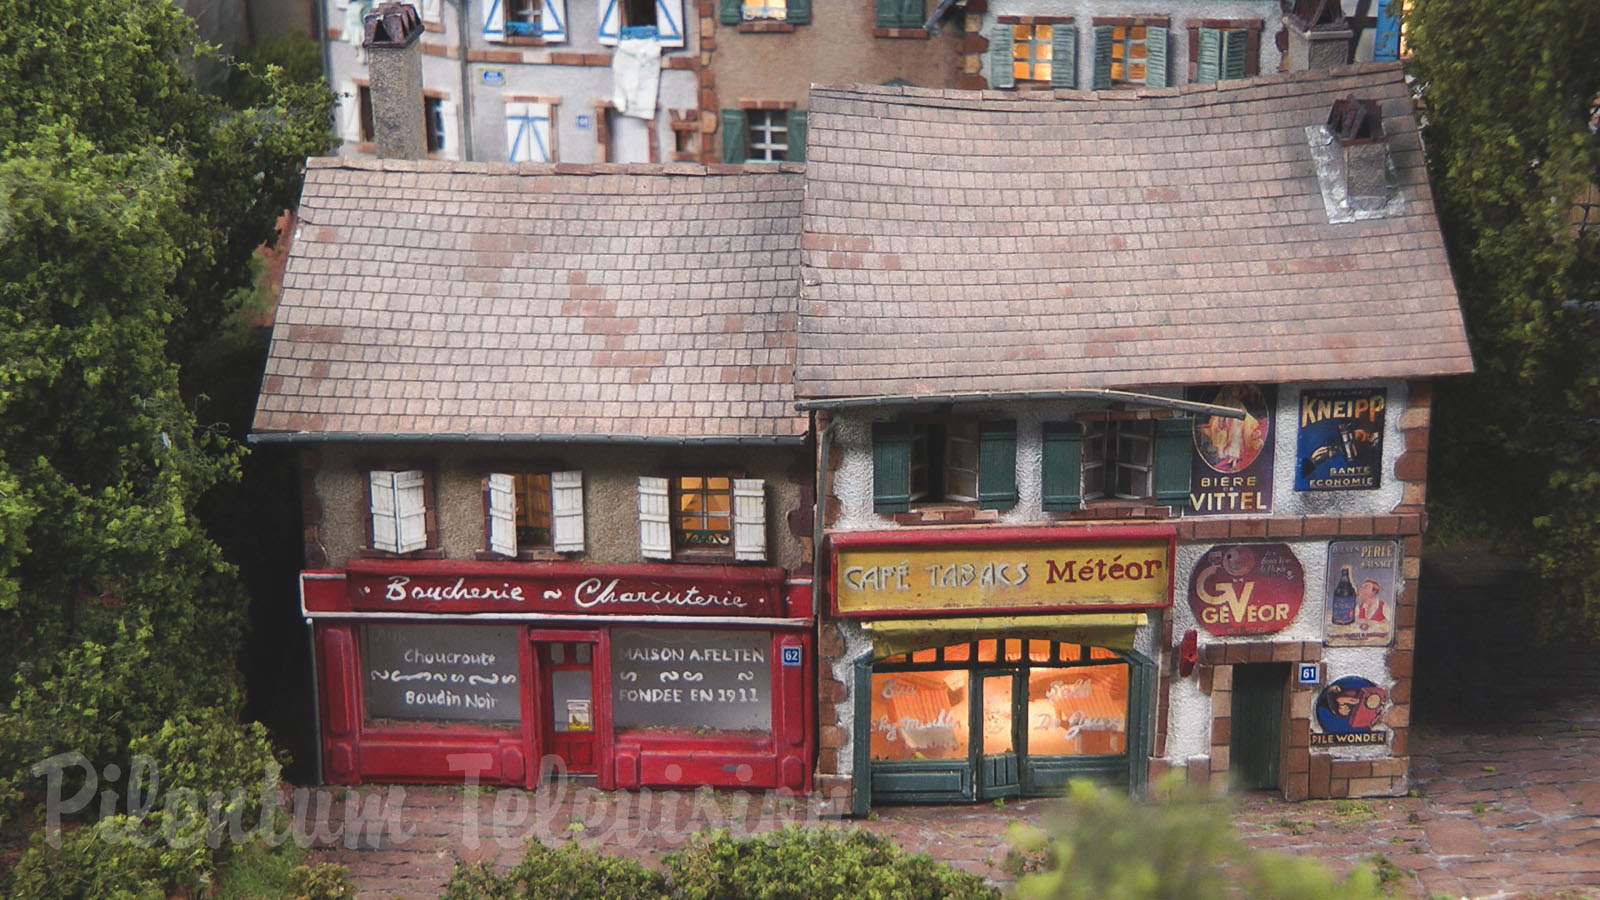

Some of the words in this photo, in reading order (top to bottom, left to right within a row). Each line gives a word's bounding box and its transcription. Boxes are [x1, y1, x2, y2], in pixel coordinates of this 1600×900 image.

[1301, 395, 1385, 428] KNEIPP
[1190, 492, 1267, 511] VITTEL
[845, 560, 912, 592] CAFÉ
[925, 561, 1029, 587] TABACS
[1047, 555, 1161, 584] Météor
[385, 575, 526, 601] Boucherie
[574, 578, 748, 608] Charcuterie
[404, 648, 497, 666] Choucroute
[621, 647, 684, 662] MAISON
[785, 650, 798, 661] 62
[1303, 668, 1315, 679] 61
[405, 690, 461, 706] Boudin
[465, 693, 499, 709] Noir
[619, 689, 682, 703] FONDEE
[690, 689, 713, 702] EN
[717, 688, 758, 702] 1911
[1311, 735, 1334, 744] PILE
[1335, 733, 1385, 743] WONDER
